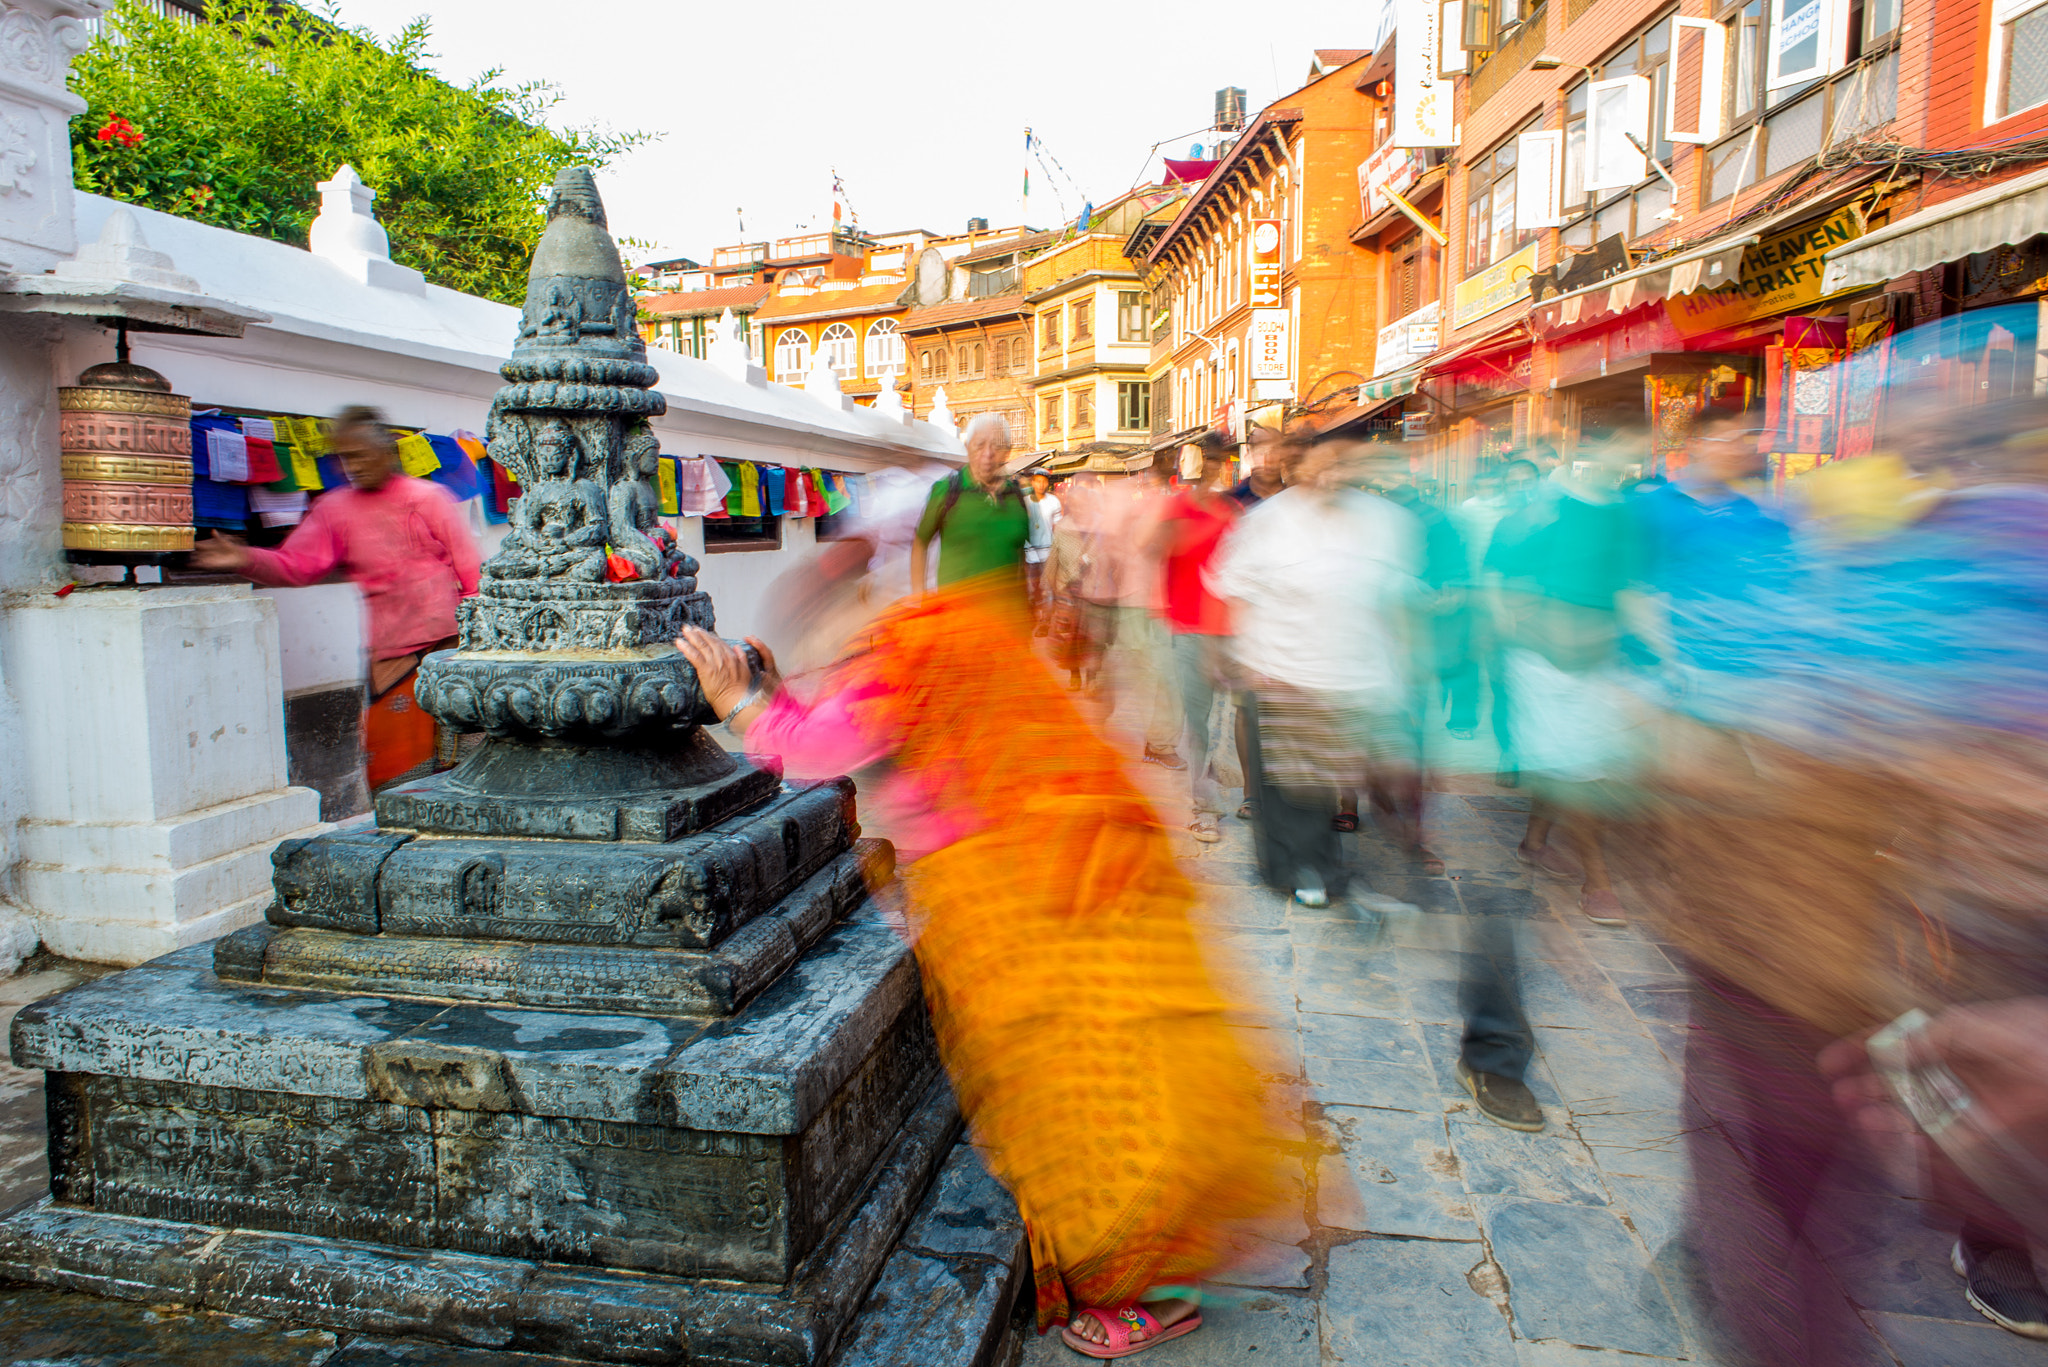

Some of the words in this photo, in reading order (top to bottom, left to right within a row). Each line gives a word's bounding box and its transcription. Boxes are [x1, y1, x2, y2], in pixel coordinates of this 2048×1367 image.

[1747, 220, 1850, 272] HEAVEN
[1682, 254, 1827, 317] HANDICRAFT
[1257, 363, 1285, 372] STORE
[1264, 334, 1279, 362] BOOK
